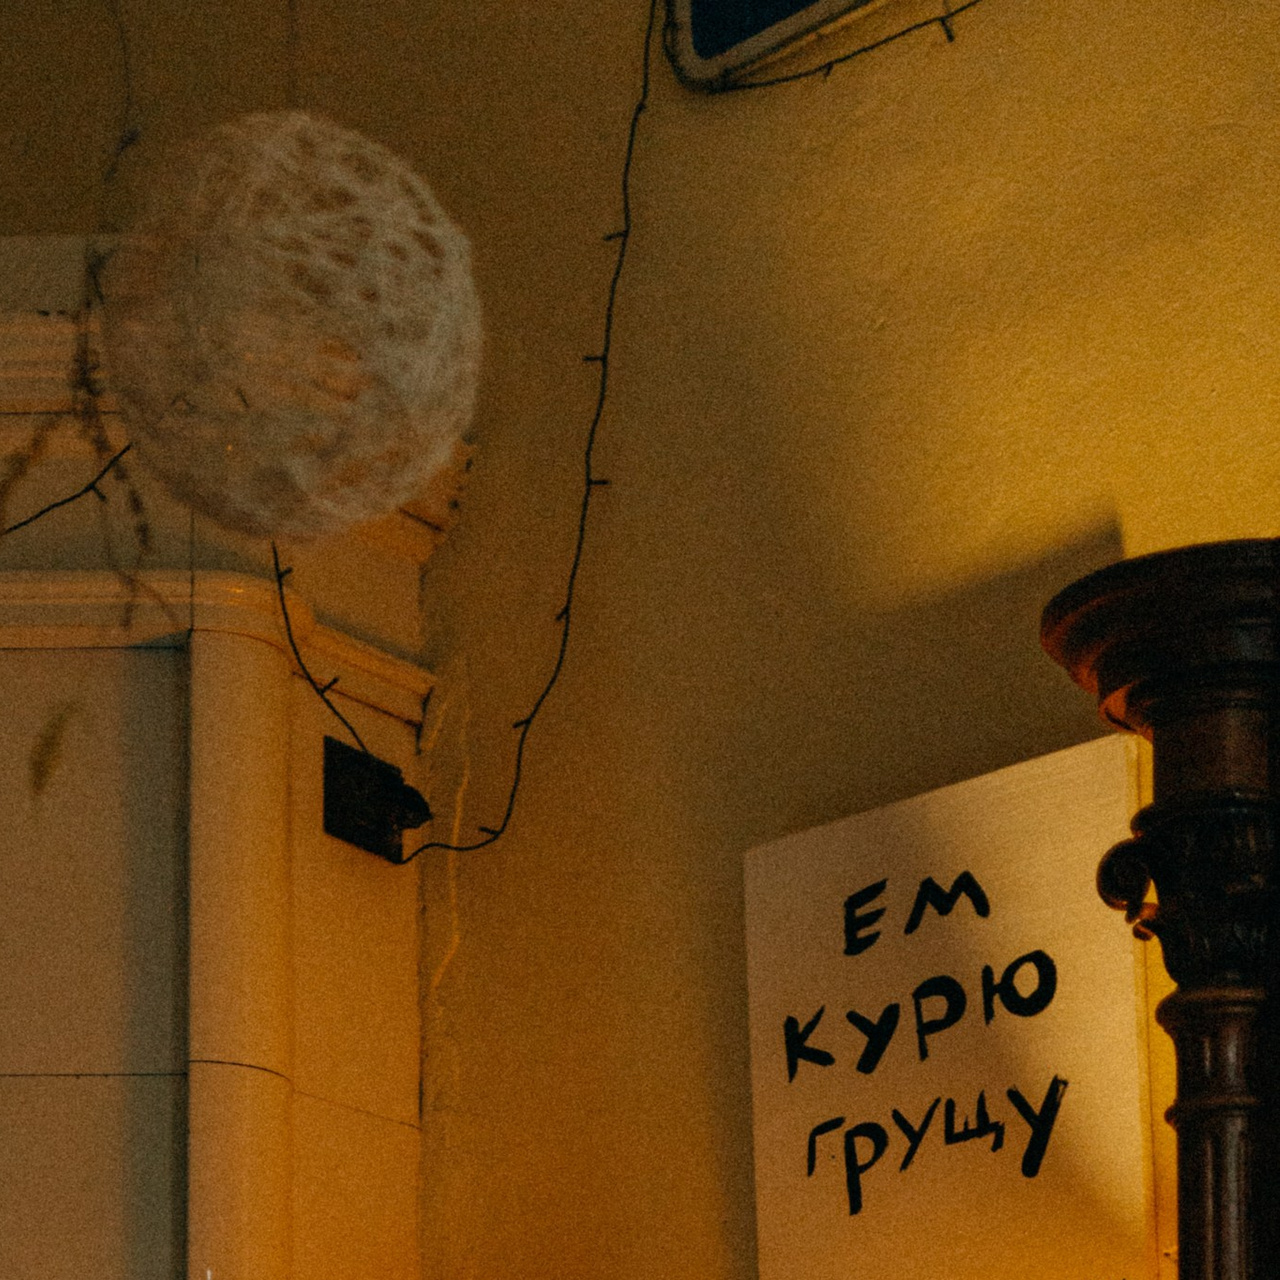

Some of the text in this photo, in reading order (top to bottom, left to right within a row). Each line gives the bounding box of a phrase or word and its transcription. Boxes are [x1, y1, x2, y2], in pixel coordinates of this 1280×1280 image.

[843, 871, 990, 956] ЕМ
[783, 949, 1057, 1083] КУРЮ
[807, 1075, 1068, 1216] ГРУЩУ
